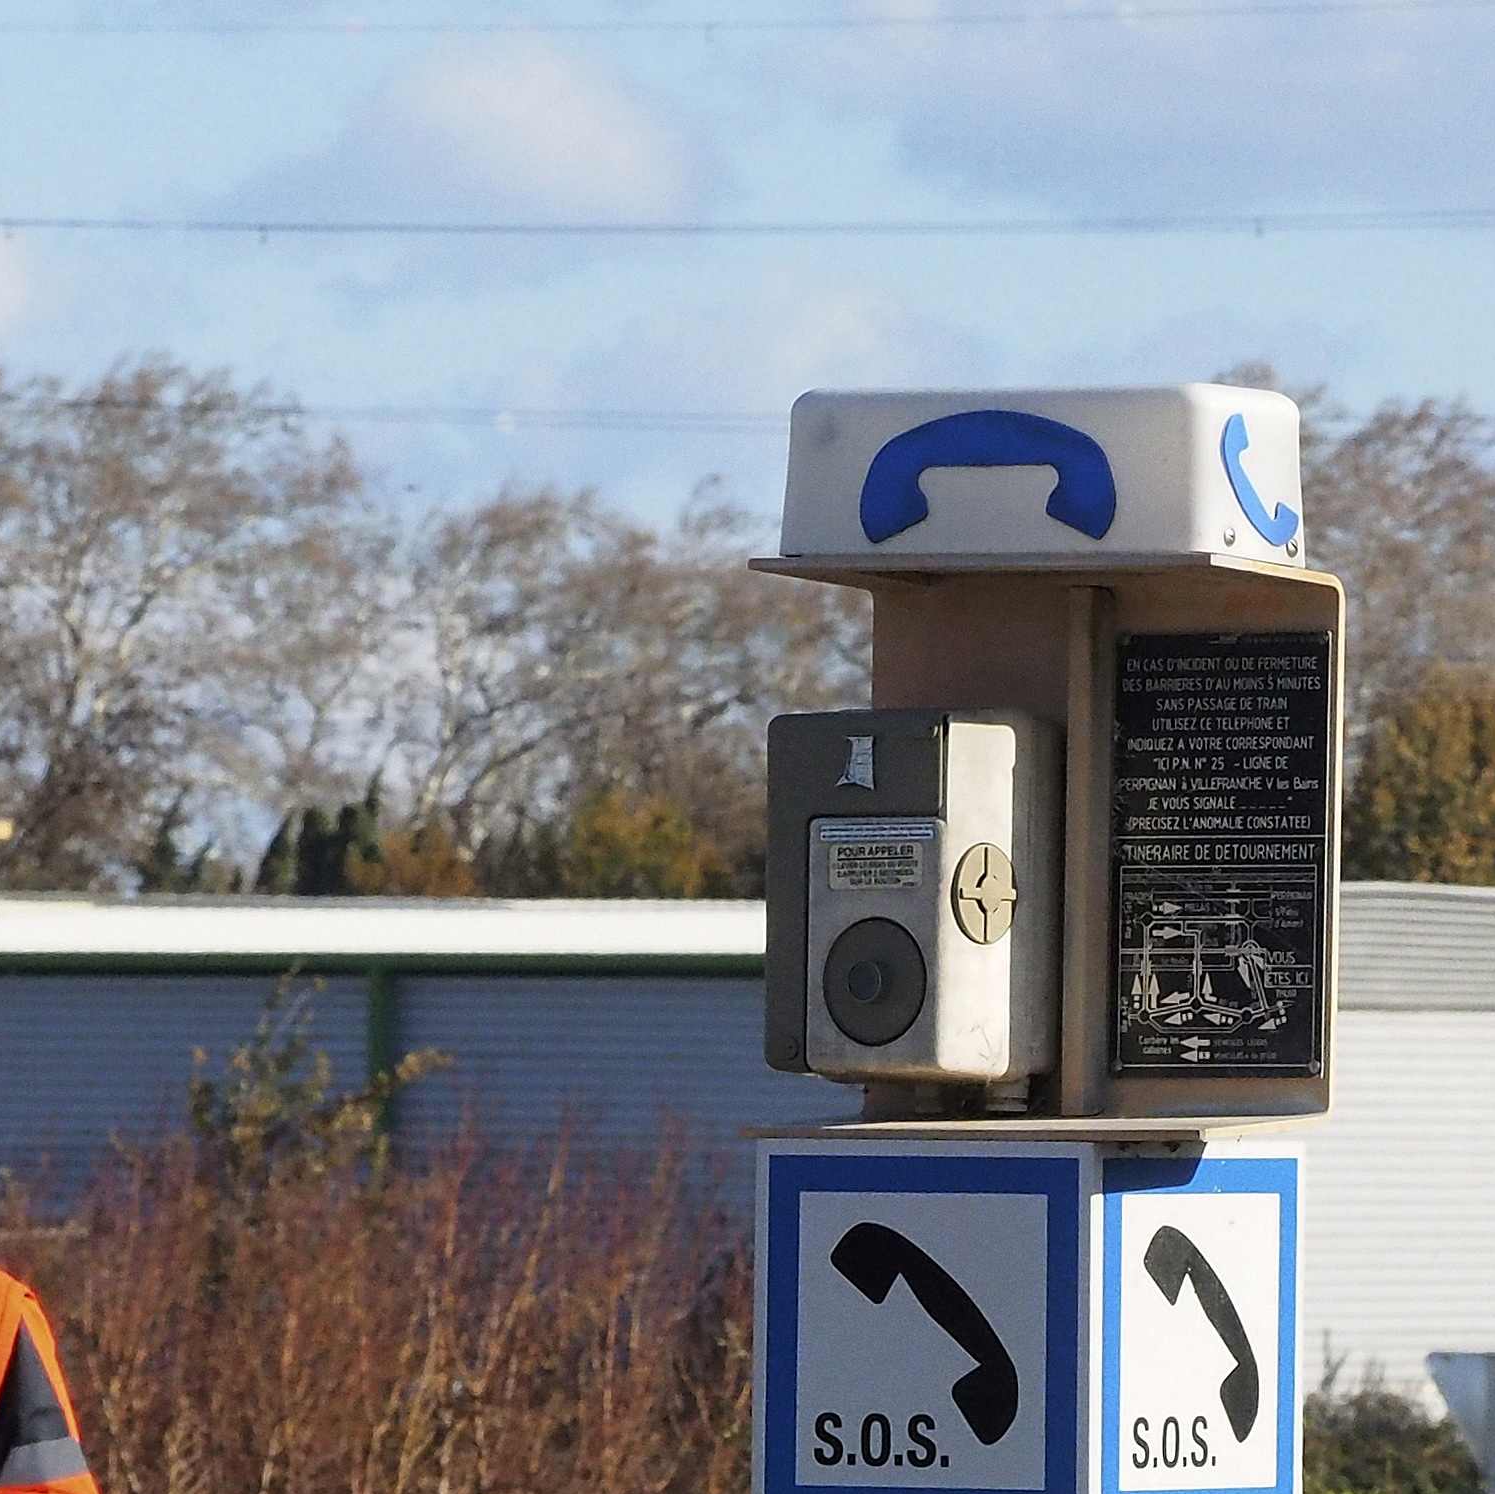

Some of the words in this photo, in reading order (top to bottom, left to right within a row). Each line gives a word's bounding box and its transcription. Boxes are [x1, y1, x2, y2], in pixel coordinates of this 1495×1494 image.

[1126, 658, 1140, 672] EN
[1143, 658, 1164, 671] CAS
[1167, 657, 1220, 671] D'INCIDENT
[1225, 657, 1240, 670] OU
[1242, 657, 1254, 670] DE
[1258, 656, 1317, 670] FERMETURE
[1122, 678, 1143, 692] DES
[1145, 678, 1202, 692] BARRIERES
[1205, 677, 1230, 691] D'AU
[1234, 677, 1264, 690] MOINS
[1277, 676, 1321, 690] MINUTES
[1155, 698, 1185, 711] SANS
[1187, 698, 1237, 711] PASSAGE
[1240, 697, 1253, 710] DE
[1256, 697, 1287, 710] TRAIN
[1152, 718, 1197, 731] UTILISEZ
[1200, 718, 1212, 731] CE
[1215, 717, 1274, 730] TELEPHONE
[1277, 717, 1290, 729] ET
[1127, 738, 1174, 751] INDIQUEZ
[1188, 737, 1223, 750] VOTRE
[1226, 736, 1314, 750] CORRESPONDANT
[1195, 756, 1206, 769] N°
[1211, 757, 1224, 770] 25
[1243, 757, 1272, 770] LIGNE
[1275, 756, 1289, 769] DE
[1119, 778, 1176, 791] PERPIGNAN
[1190, 777, 1262, 791] VILLEFRANCHE
[1266, 777, 1274, 790] V
[1147, 797, 1159, 810] JE
[1162, 797, 1190, 810] VOUS
[1193, 796, 1236, 810] SIGNALE
[1128, 816, 1179, 831] (PRECISEZ
[1183, 816, 1244, 830] L'ANOMALIE
[837, 847, 866, 857] POUR
[867, 845, 913, 856] APPELER
[1195, 845, 1210, 860] DE
[1215, 843, 1315, 860] DETOURNEMENT
[1268, 952, 1296, 963] VOUS
[1296, 972, 1308, 984] ICI
[813, 1411, 951, 1469] S.O.S.
[1132, 1415, 1218, 1470] S.O.S.
